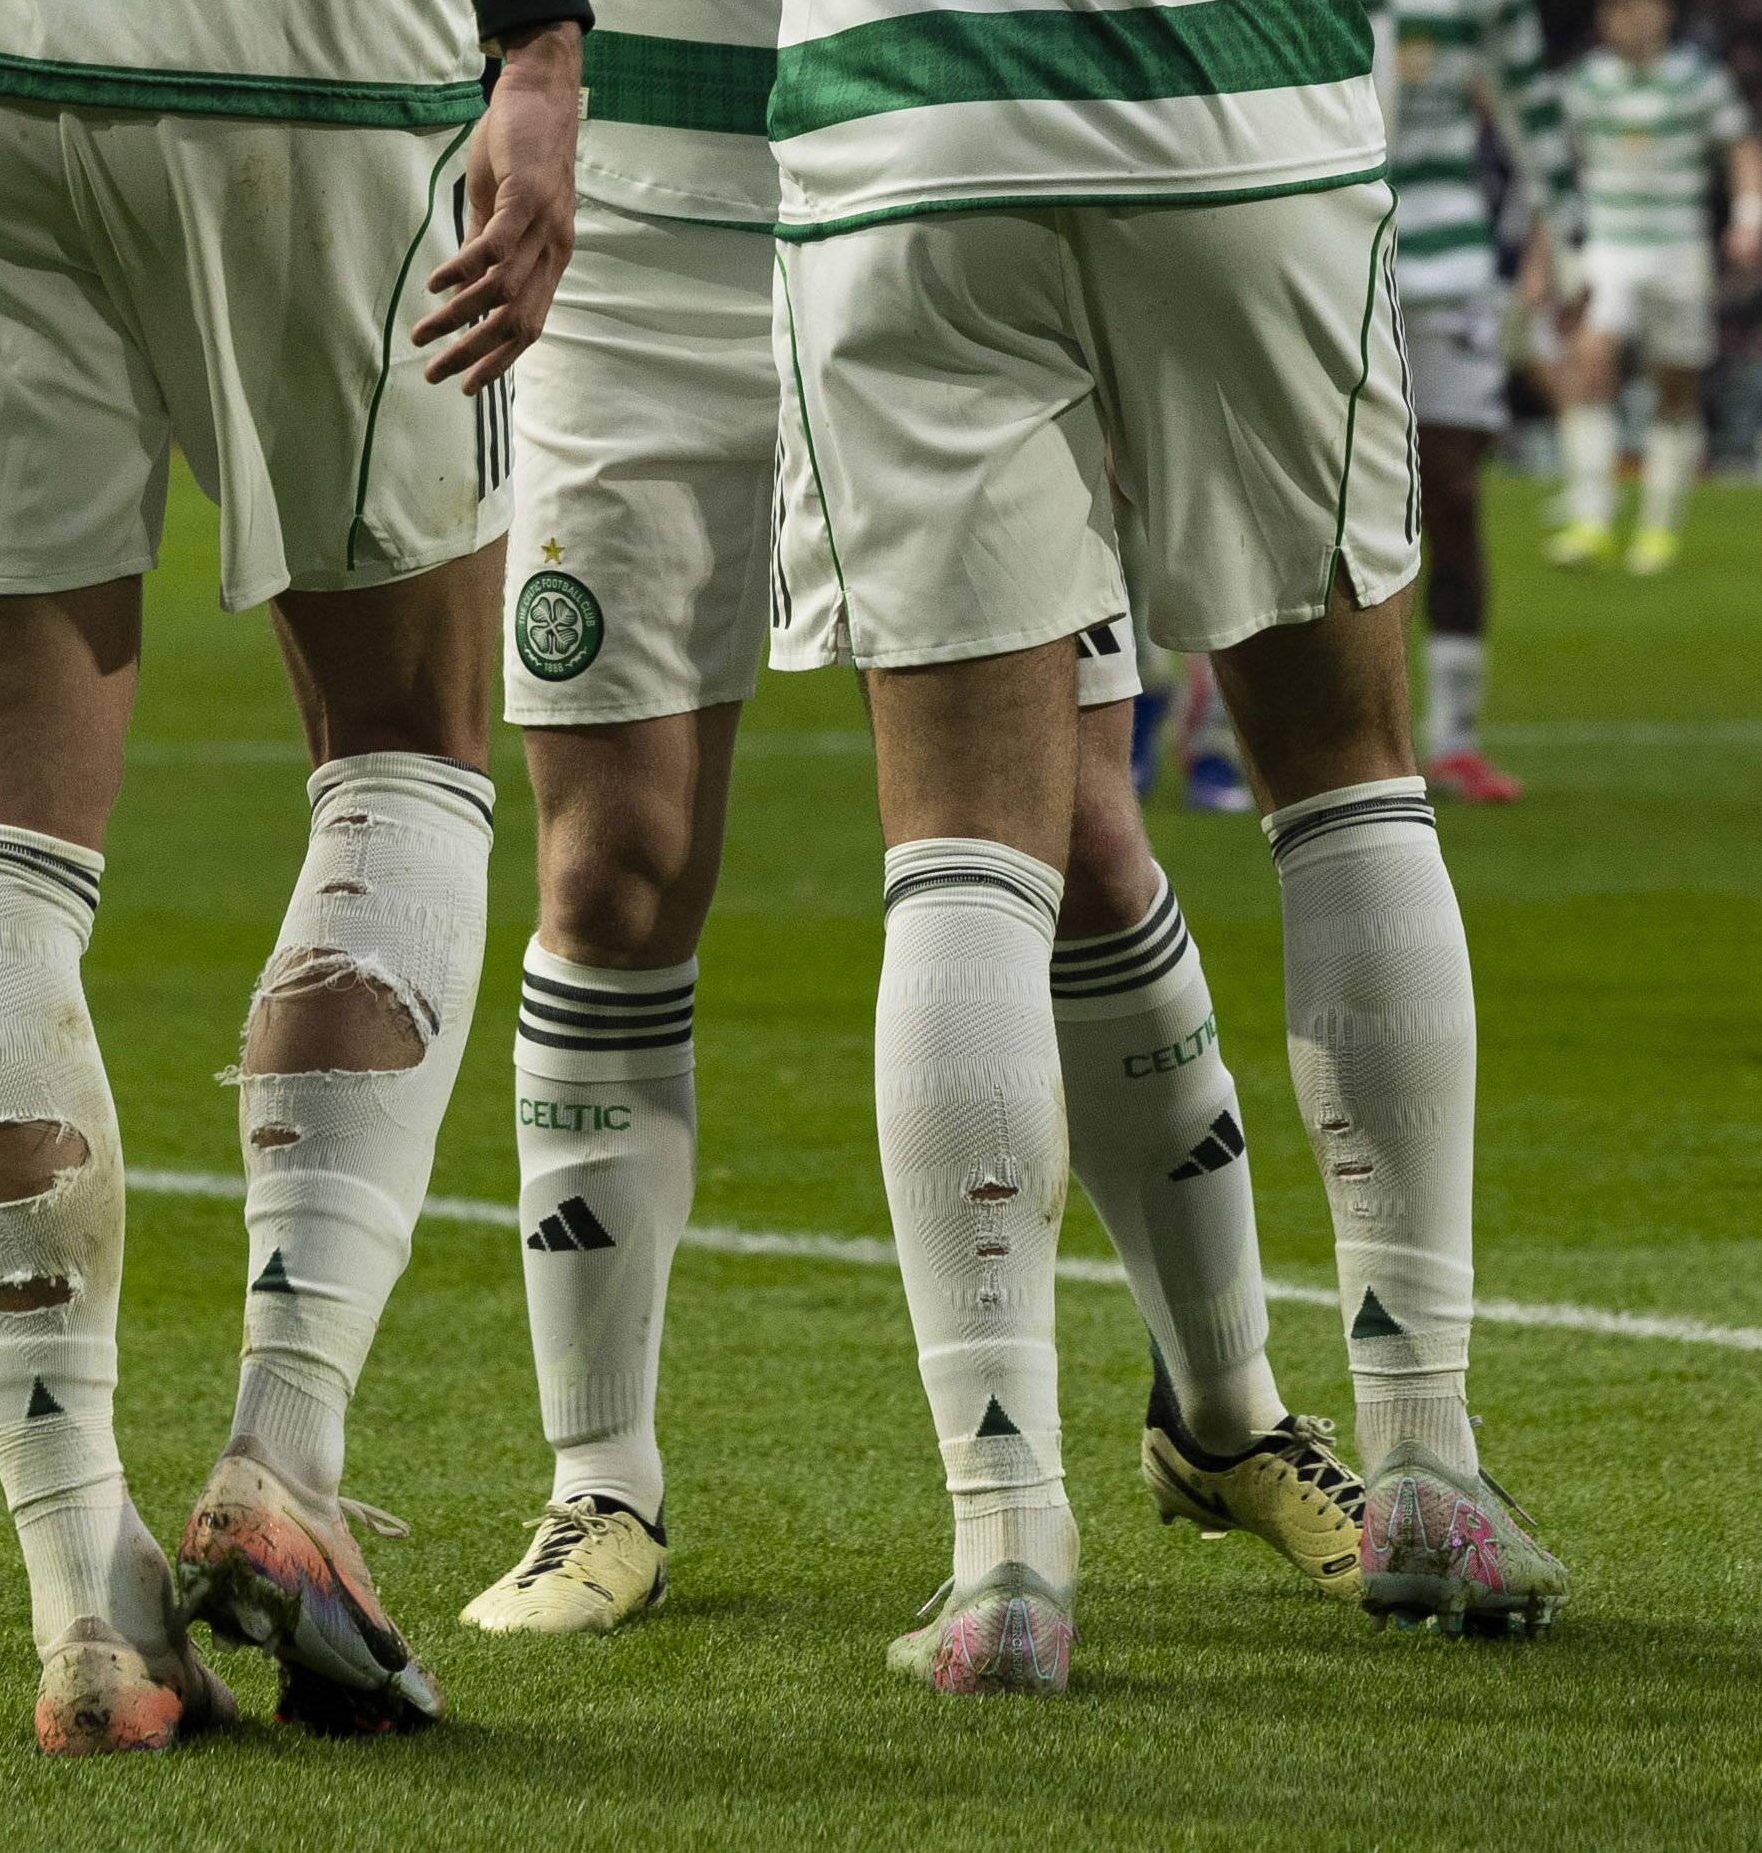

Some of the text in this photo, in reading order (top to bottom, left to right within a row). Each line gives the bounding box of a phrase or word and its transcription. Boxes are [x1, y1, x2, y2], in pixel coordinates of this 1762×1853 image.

[541, 578, 583, 602] FOOTBALL
[581, 600, 596, 627] CLUB
[520, 1098, 631, 1131] CELTIC
